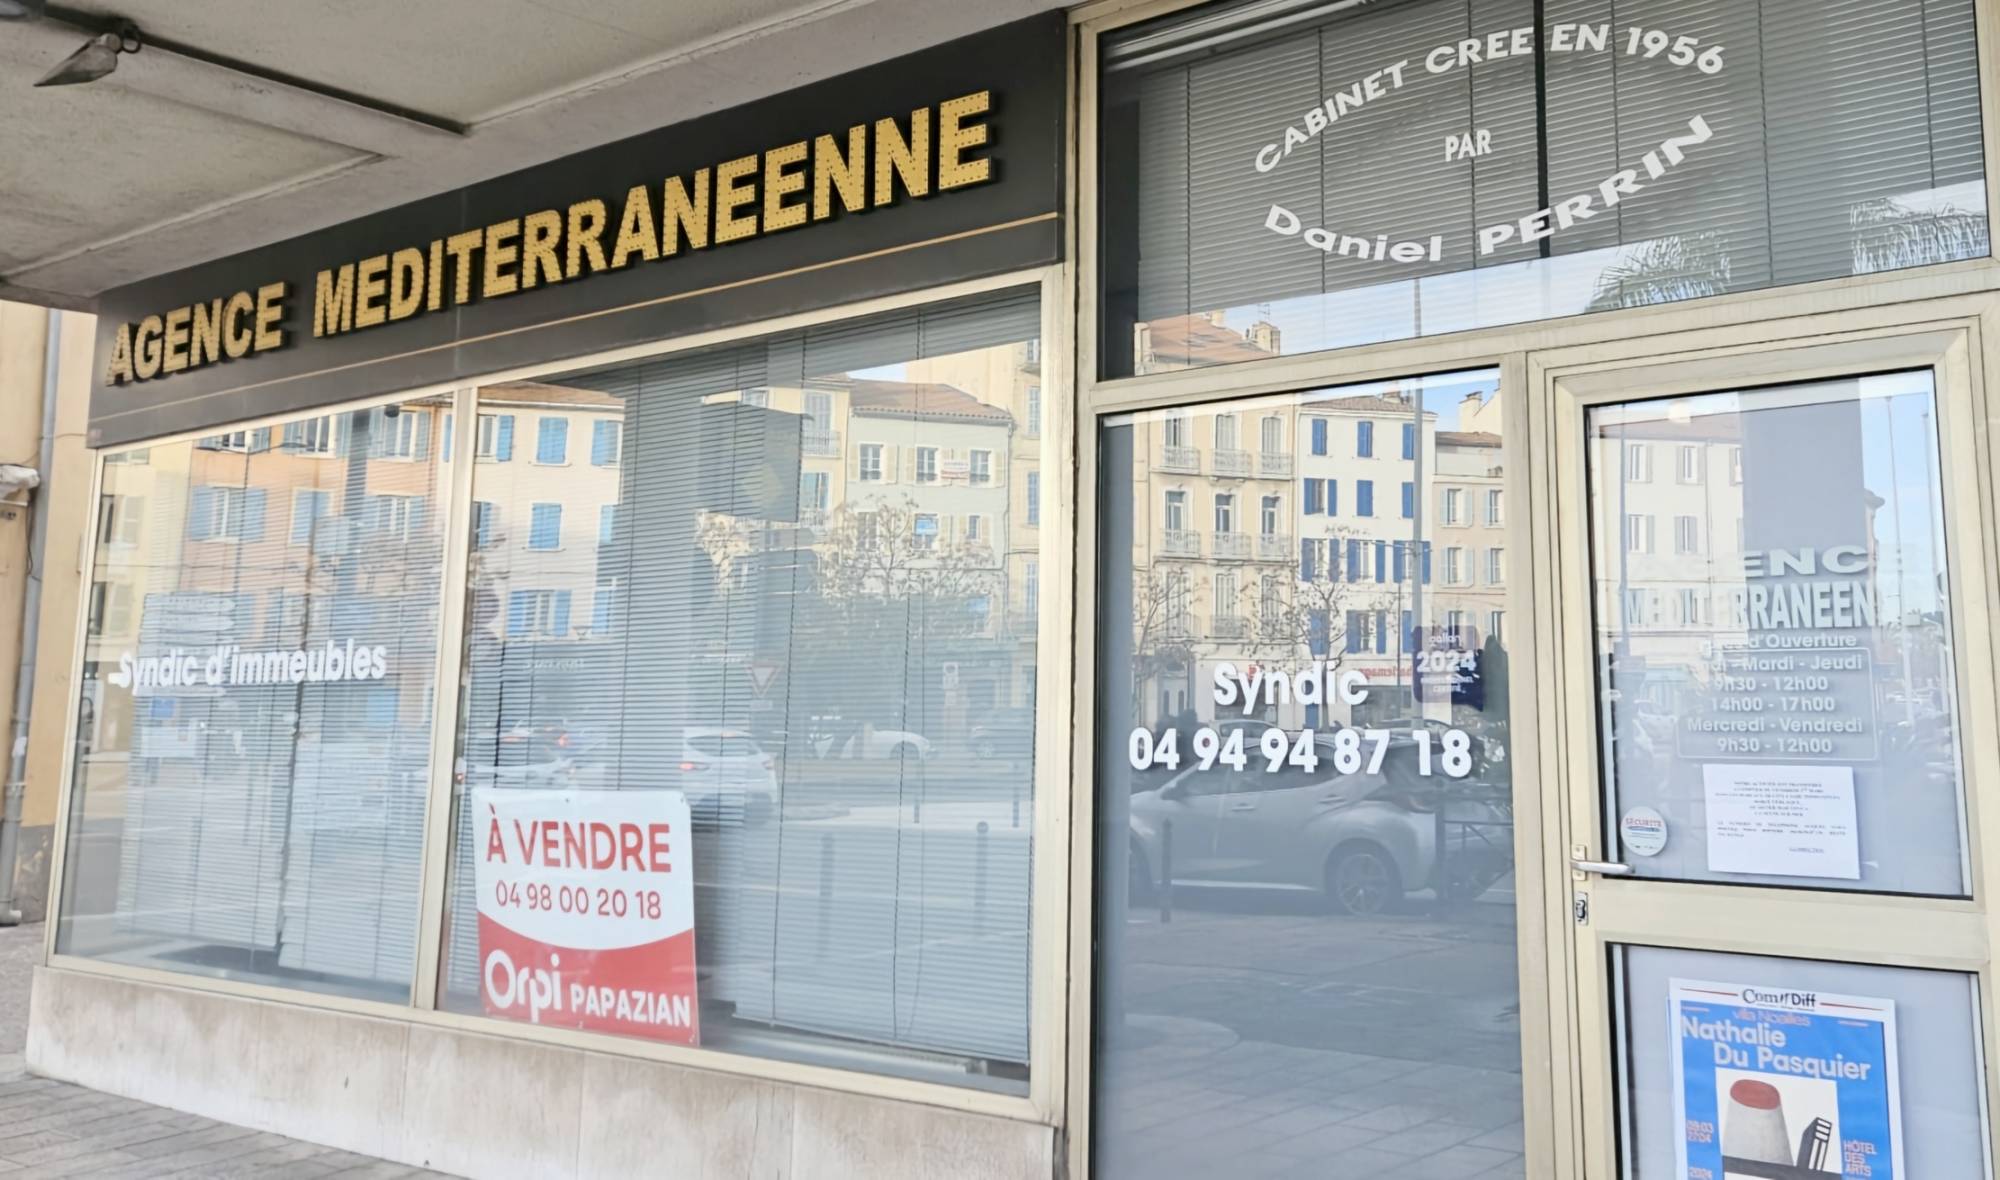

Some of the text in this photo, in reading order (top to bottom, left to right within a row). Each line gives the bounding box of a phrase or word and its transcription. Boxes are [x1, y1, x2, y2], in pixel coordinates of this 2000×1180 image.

[1255, 23, 1726, 173] CABINET CREE EN 1956
[1445, 129, 1492, 162] PAR
[1264, 114, 1714, 263] Daniel PERRIN
[105, 90, 990, 387] AGENCE MEDITERRANEENNE
[1749, 634, 1857, 649] d'Ouverture
[119, 638, 388, 696] Syndic d'immeubles
[1416, 649, 1477, 673] 2024
[1743, 655, 1794, 671] Mardi
[1810, 654, 1863, 671] Jeudi
[1213, 661, 1368, 716] Syndic
[1713, 677, 1757, 691] 9h30
[1774, 676, 1829, 691] 12h00
[1711, 697, 1763, 712] 14h00
[1781, 697, 1835, 712] 17h00
[1687, 718, 1766, 733] Mercredi
[1779, 718, 1863, 733] Vendredi
[1128, 727, 1472, 778] 04 94 94 87 18
[1717, 739, 1760, 753] 9h30
[1777, 738, 1833, 753] 12h00
[487, 803, 672, 873] À VENDRE
[495, 879, 662, 920] 04 98 00 20 18
[485, 949, 691, 1028] Orpi PAPAZIAN
[1681, 1016, 1787, 1048] Nathalie
[1713, 1042, 1871, 1081] Du Pasquier
[1845, 1164, 1872, 1177] ARTS
